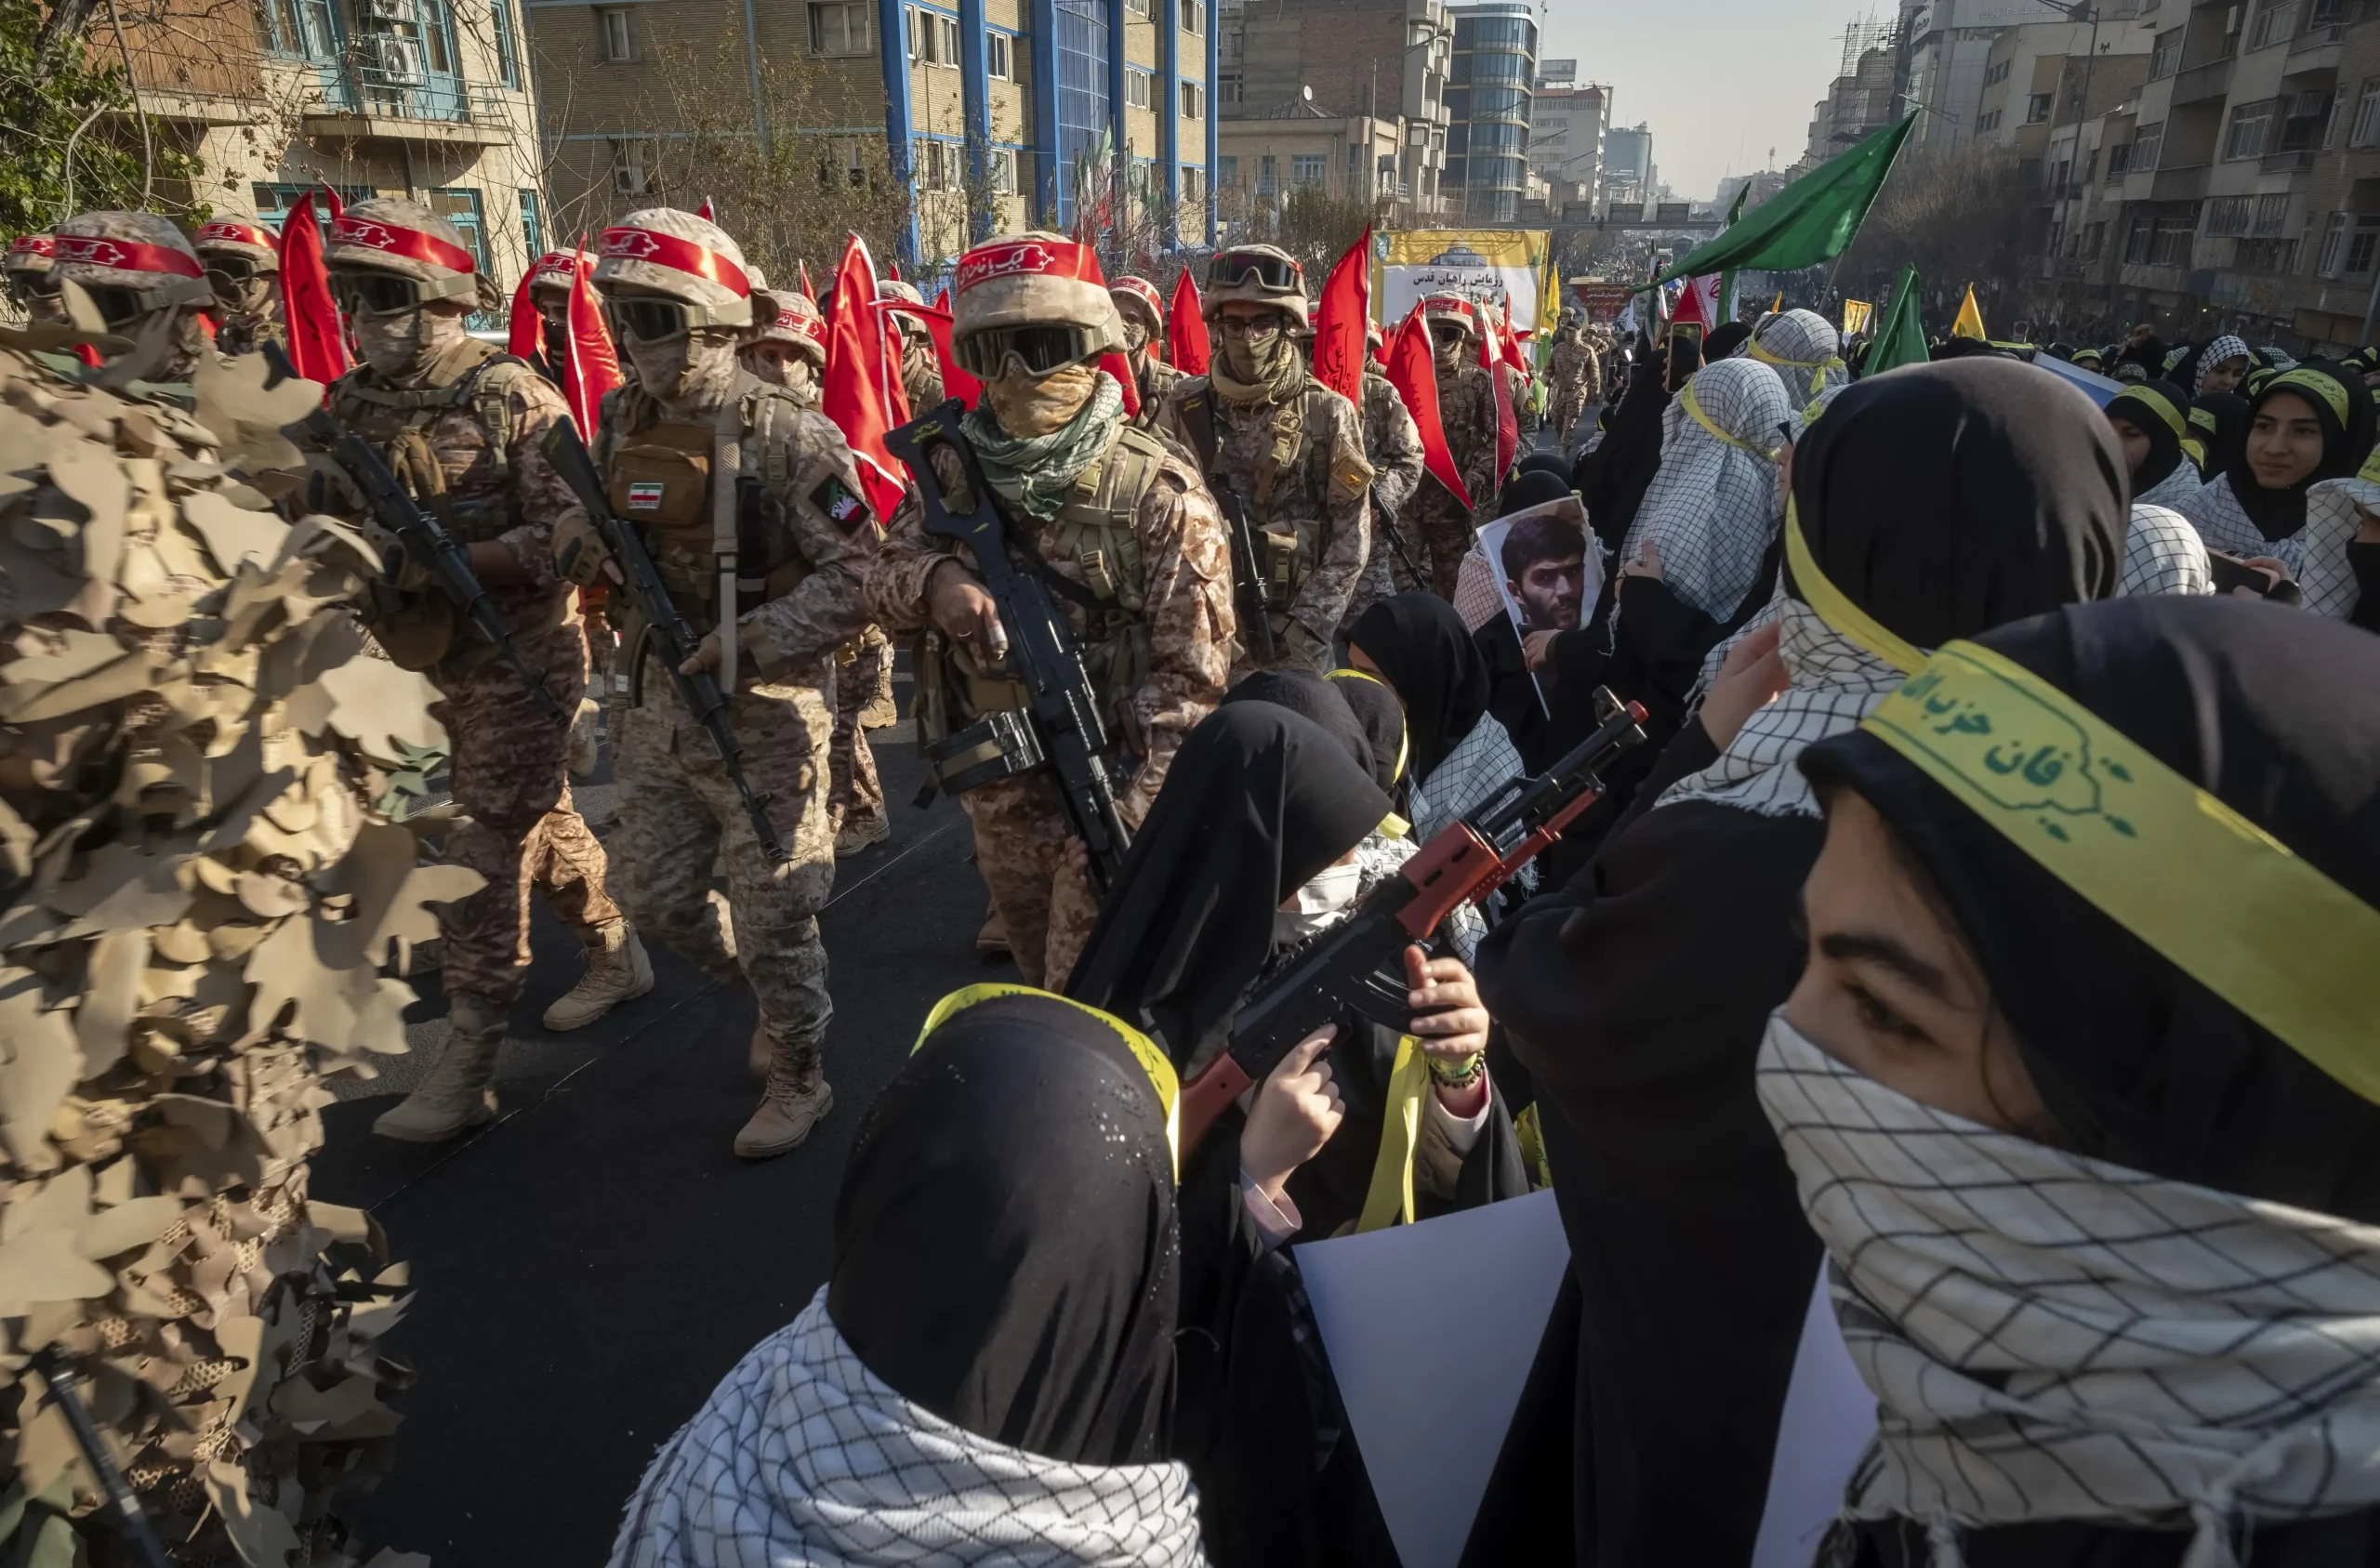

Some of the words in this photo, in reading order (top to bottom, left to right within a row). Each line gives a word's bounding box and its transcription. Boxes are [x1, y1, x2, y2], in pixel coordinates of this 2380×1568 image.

[987, 257, 995, 275] یا
[996, 246, 1030, 270] لبیک
[1413, 271, 1435, 285] قدس
[1437, 272, 1466, 286] راهیان
[1470, 272, 1503, 287] رزمایش
[1920, 692, 1993, 735] حزب
[1983, 740, 2071, 787] فان
